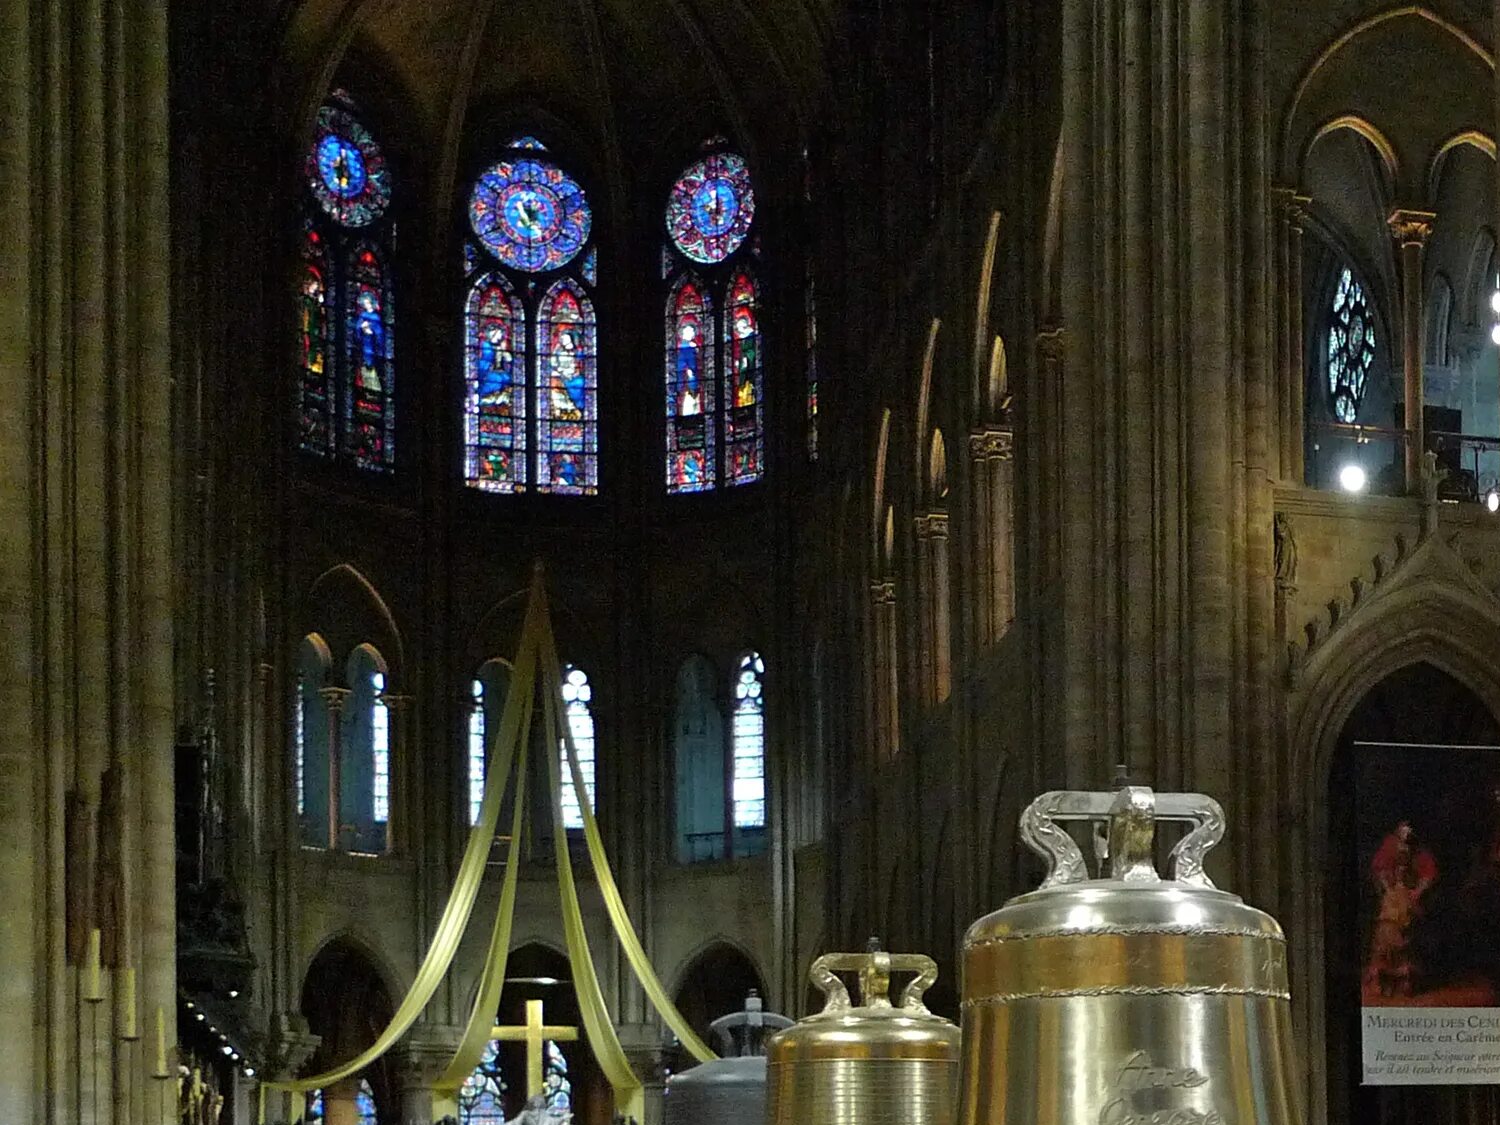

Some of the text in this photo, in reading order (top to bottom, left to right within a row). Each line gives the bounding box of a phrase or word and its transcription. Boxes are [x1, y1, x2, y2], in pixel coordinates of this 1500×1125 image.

[1367, 1015, 1437, 1029] MERCREDI
[1440, 1017, 1465, 1029] DES
[1394, 1030, 1434, 1043] Entrée
[1437, 1034, 1453, 1043] en
